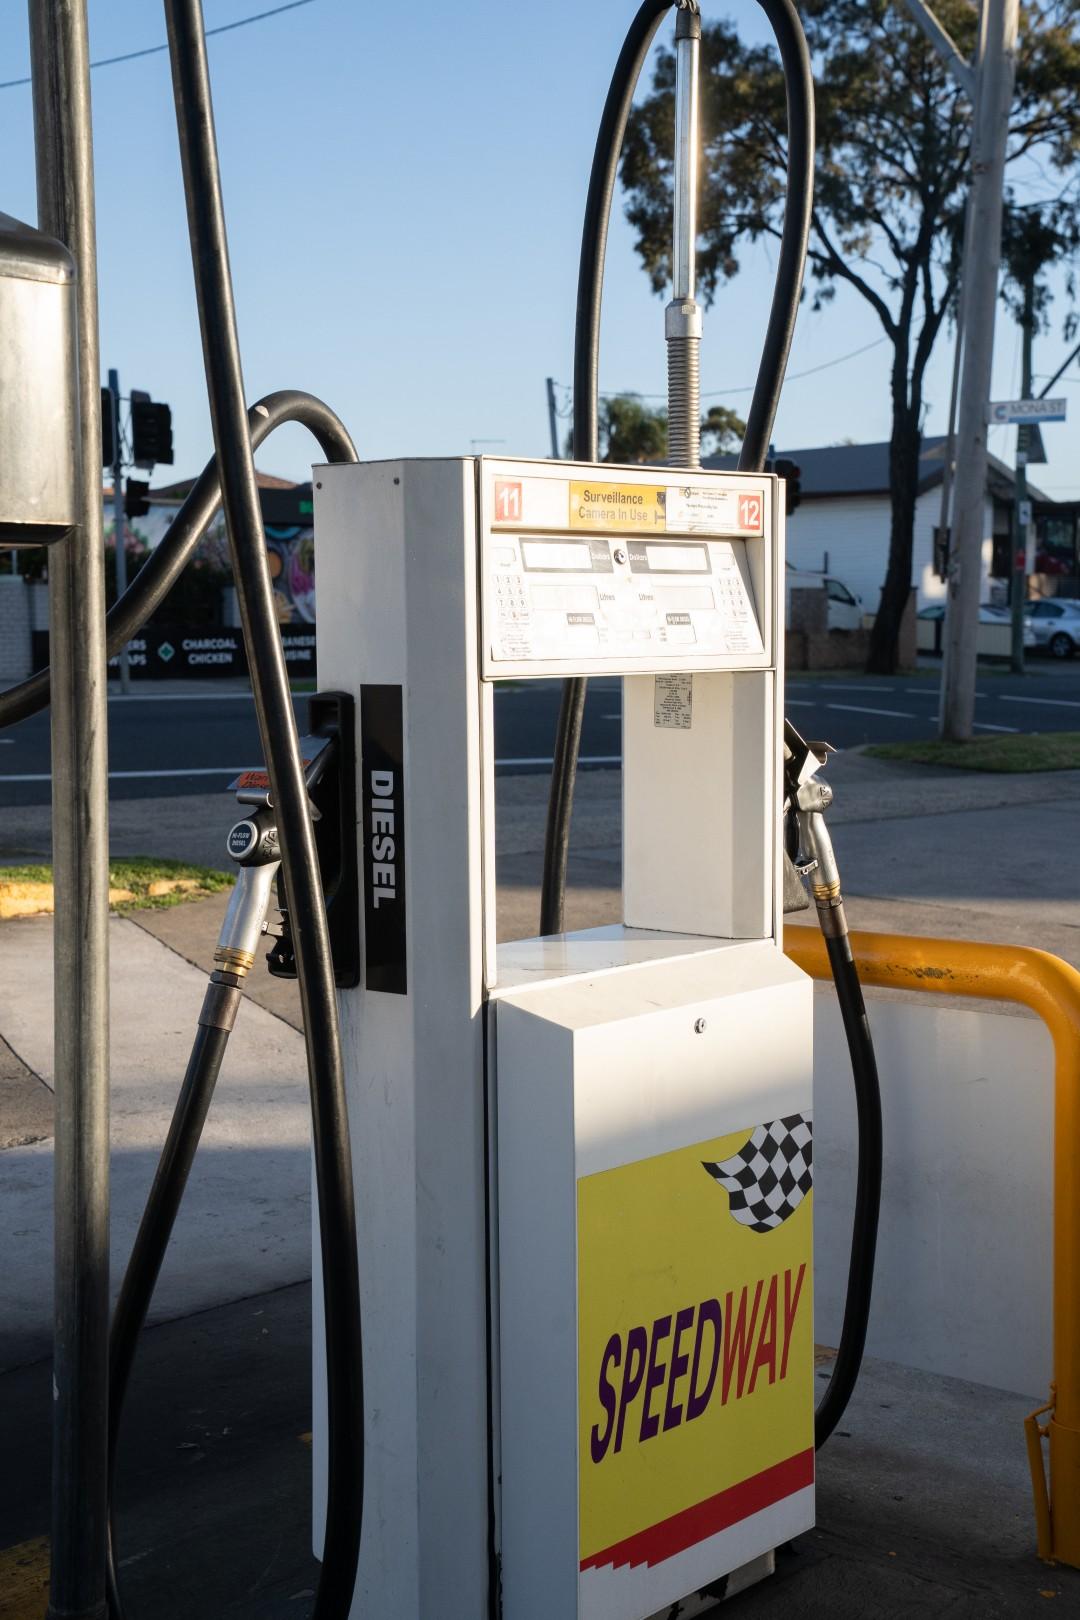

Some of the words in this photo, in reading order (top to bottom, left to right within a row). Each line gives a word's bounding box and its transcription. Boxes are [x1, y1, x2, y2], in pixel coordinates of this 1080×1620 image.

[1011, 403, 1048, 414] MONA
[1050, 402, 1063, 412] ST
[498, 488, 520, 517] 11
[583, 489, 643, 505] Surveillance
[578, 505, 616, 520] Camera
[618, 508, 627, 520] In
[630, 508, 648, 521] Use
[740, 500, 759, 526] 12
[599, 592, 616, 601] Litres
[638, 592, 654, 601] Litres
[182, 638, 237, 651] CHARCOAL
[109, 654, 147, 666] WAPS
[188, 652, 233, 665] CHICKEN
[370, 769, 396, 909] DIESEL
[590, 1263, 807, 1465] SPEEDWAY
